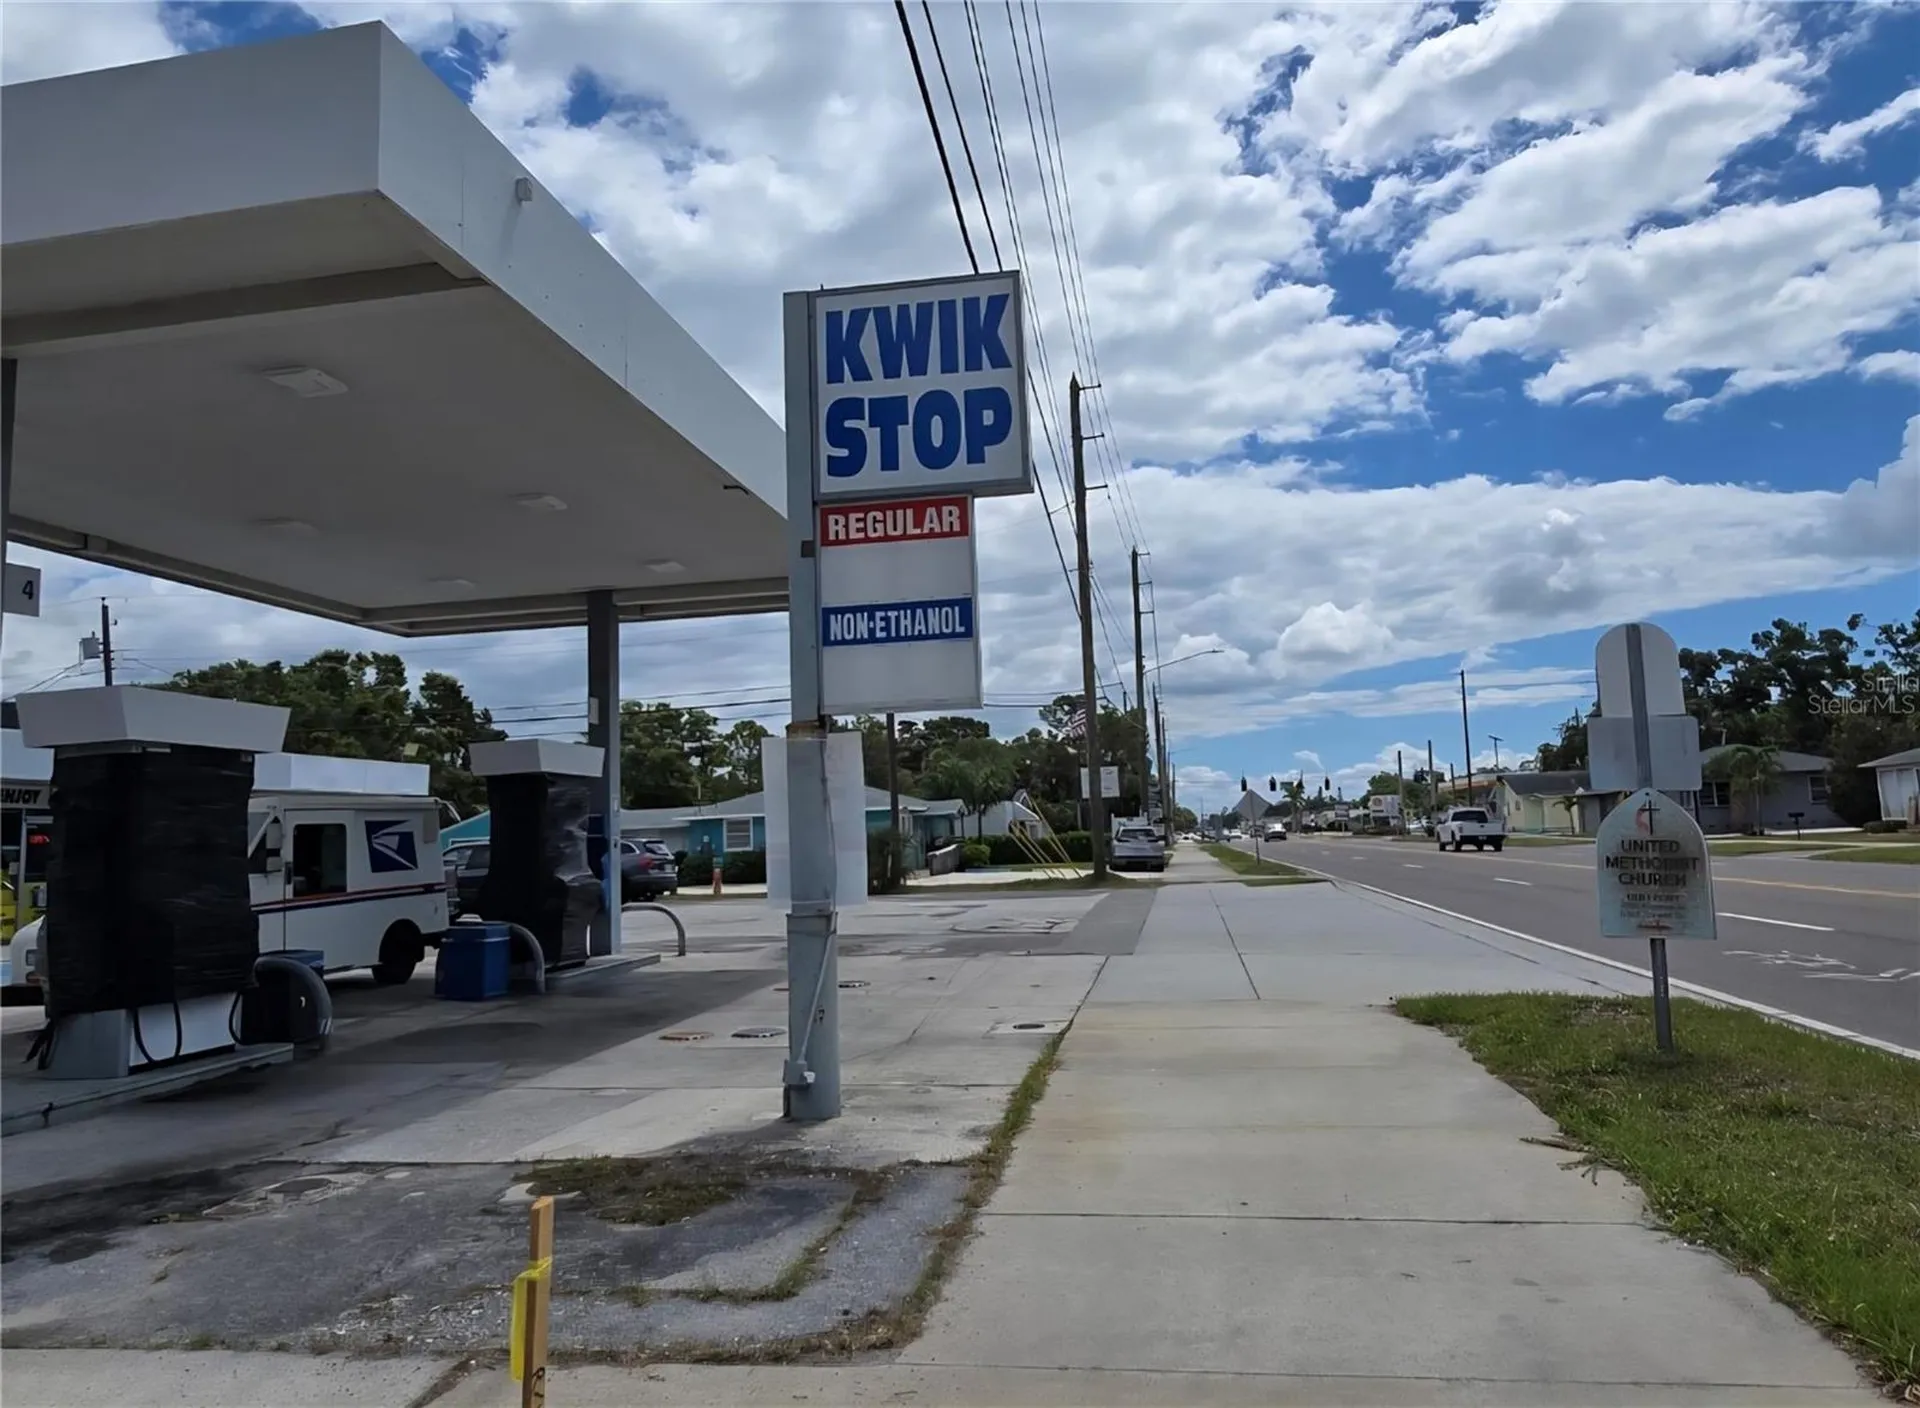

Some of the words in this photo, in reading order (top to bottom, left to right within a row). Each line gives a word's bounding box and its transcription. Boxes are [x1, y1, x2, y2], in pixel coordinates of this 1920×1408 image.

[825, 293, 1012, 384] KWIK
[825, 386, 1013, 479] STOP
[827, 504, 962, 541] REGULAR
[22, 580, 34, 600] 4
[1621, 839, 1681, 853] UNITED
[1618, 872, 1687, 887] CHURCH
